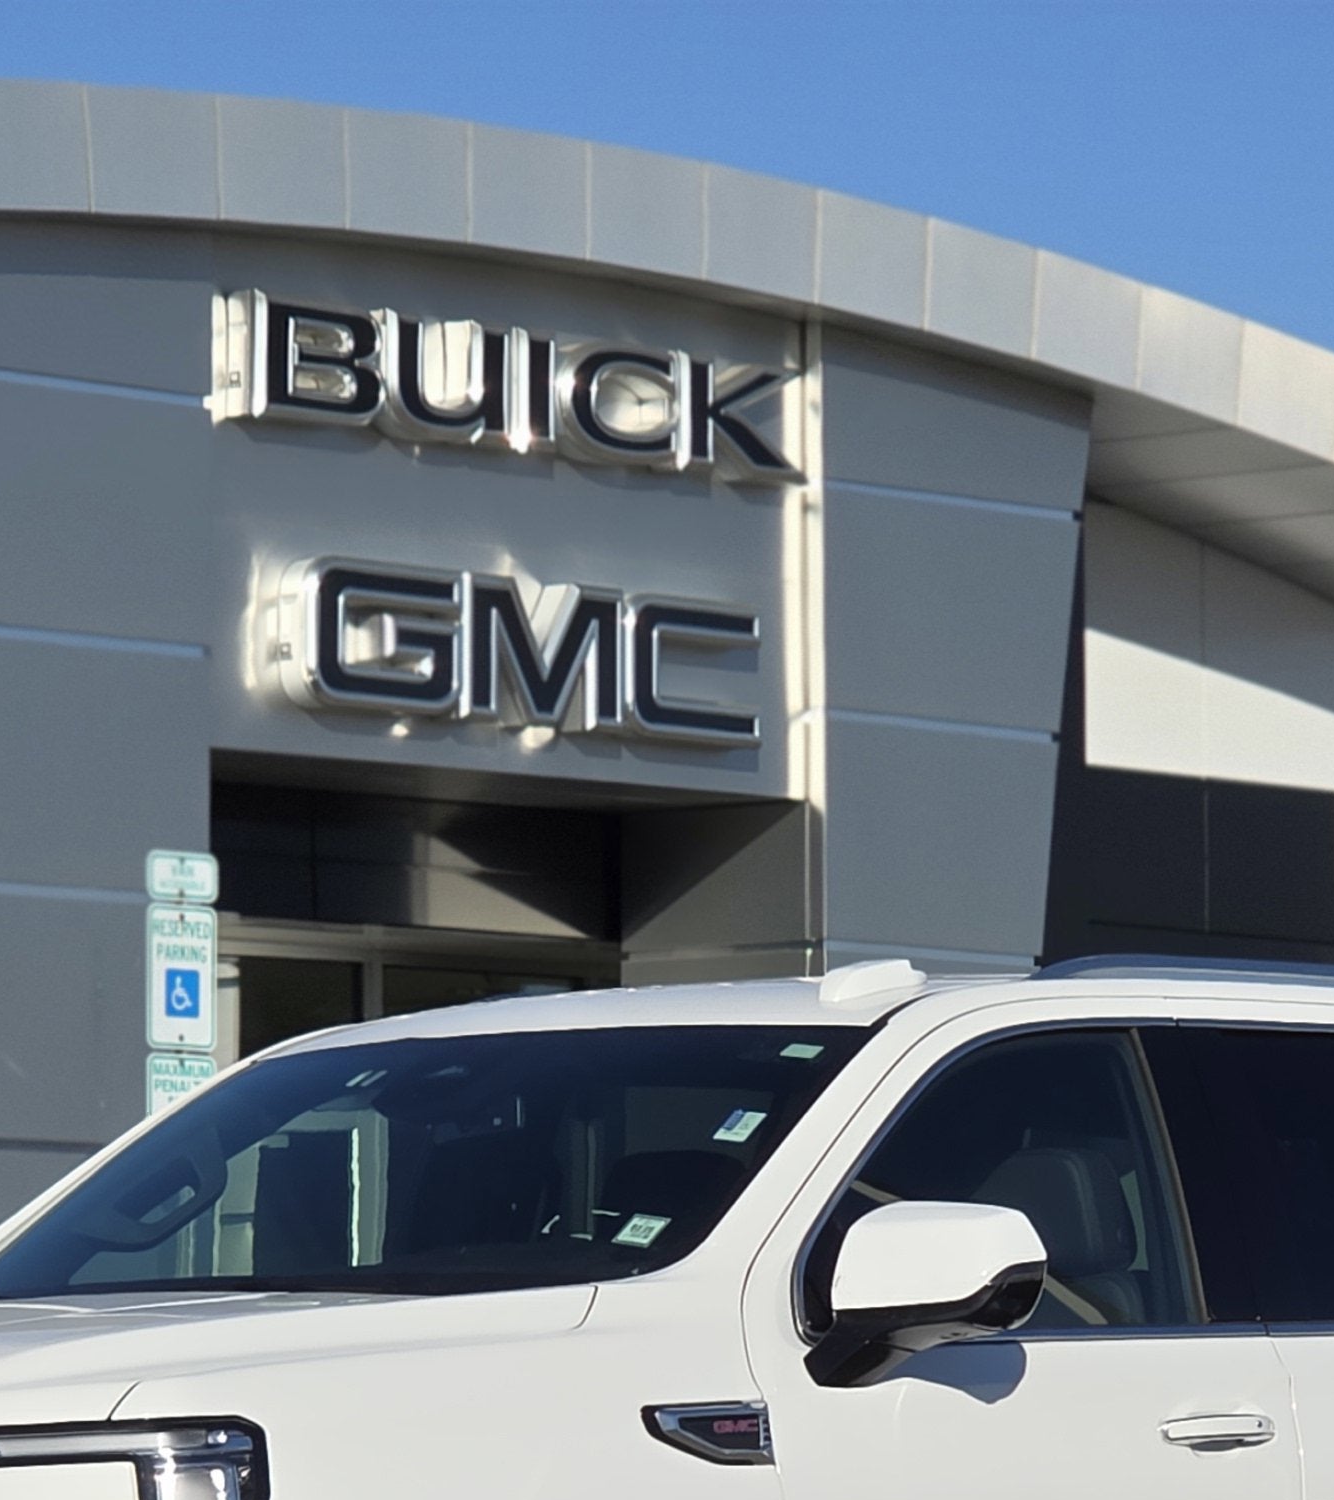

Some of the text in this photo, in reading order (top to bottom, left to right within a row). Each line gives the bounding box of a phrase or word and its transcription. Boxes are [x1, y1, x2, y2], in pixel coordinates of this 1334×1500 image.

[252, 288, 808, 486] BUICK
[303, 556, 761, 747] GMC
[152, 918, 212, 940] RESERVED
[156, 942, 208, 964] PARKING
[153, 1062, 212, 1078] MAXIMUM
[713, 1418, 759, 1434] GMC
